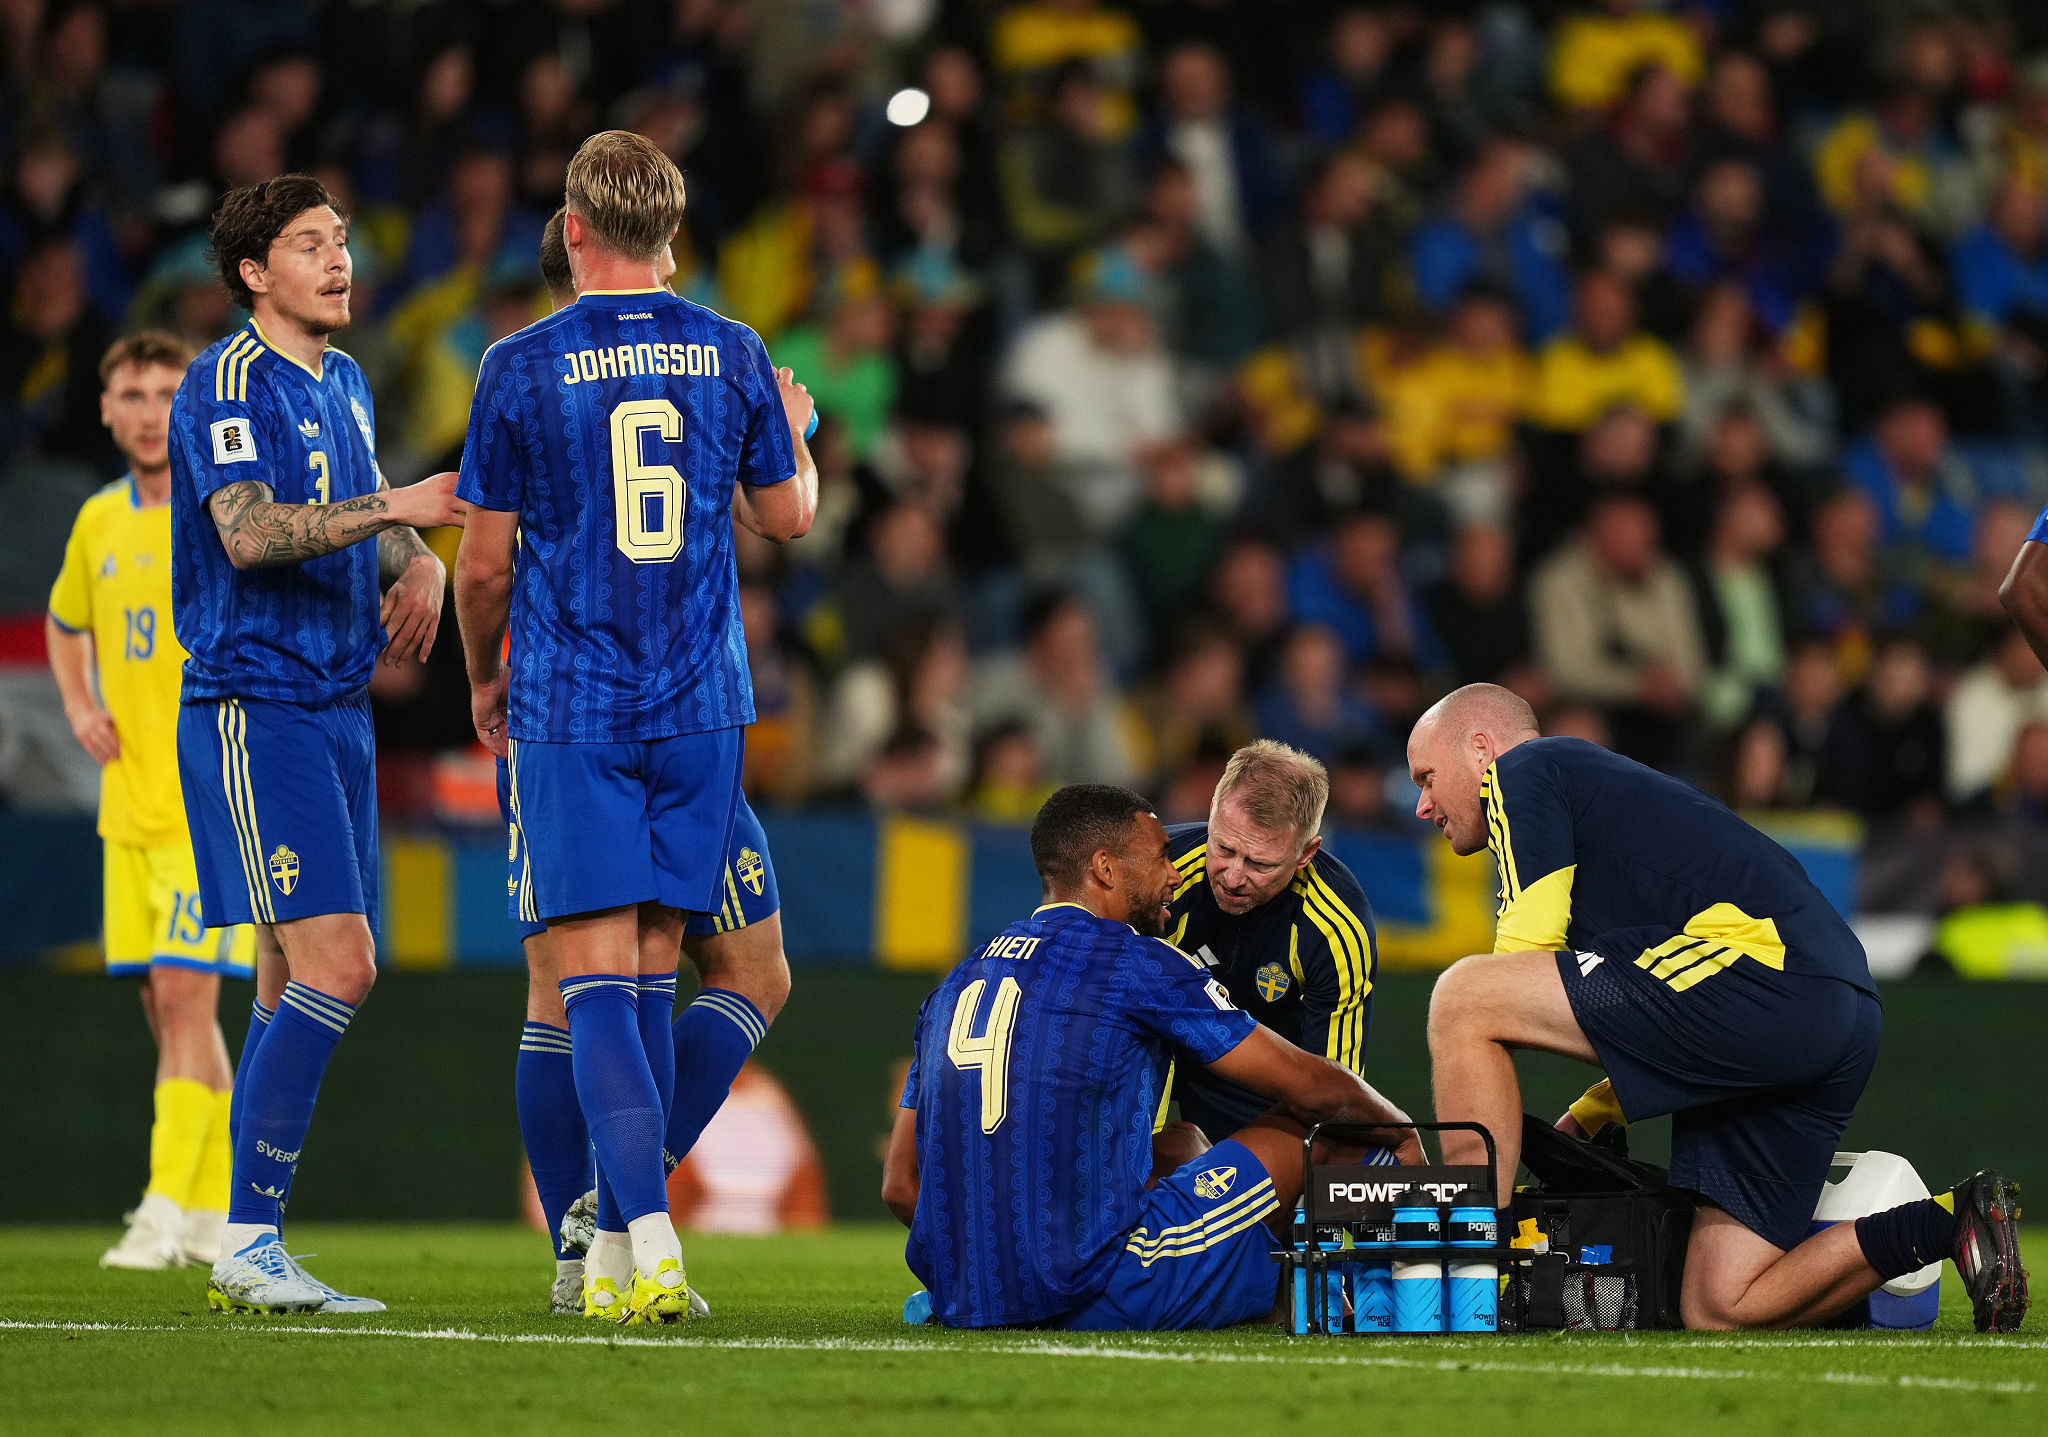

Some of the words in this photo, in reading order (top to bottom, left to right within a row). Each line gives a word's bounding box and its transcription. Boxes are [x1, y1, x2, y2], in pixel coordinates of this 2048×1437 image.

[563, 343, 720, 385] JOHANSSON
[308, 451, 330, 506] 3
[610, 399, 687, 564] 6
[124, 607, 156, 661] 19
[981, 936, 1042, 960] HIEN
[947, 976, 1023, 1135] 4
